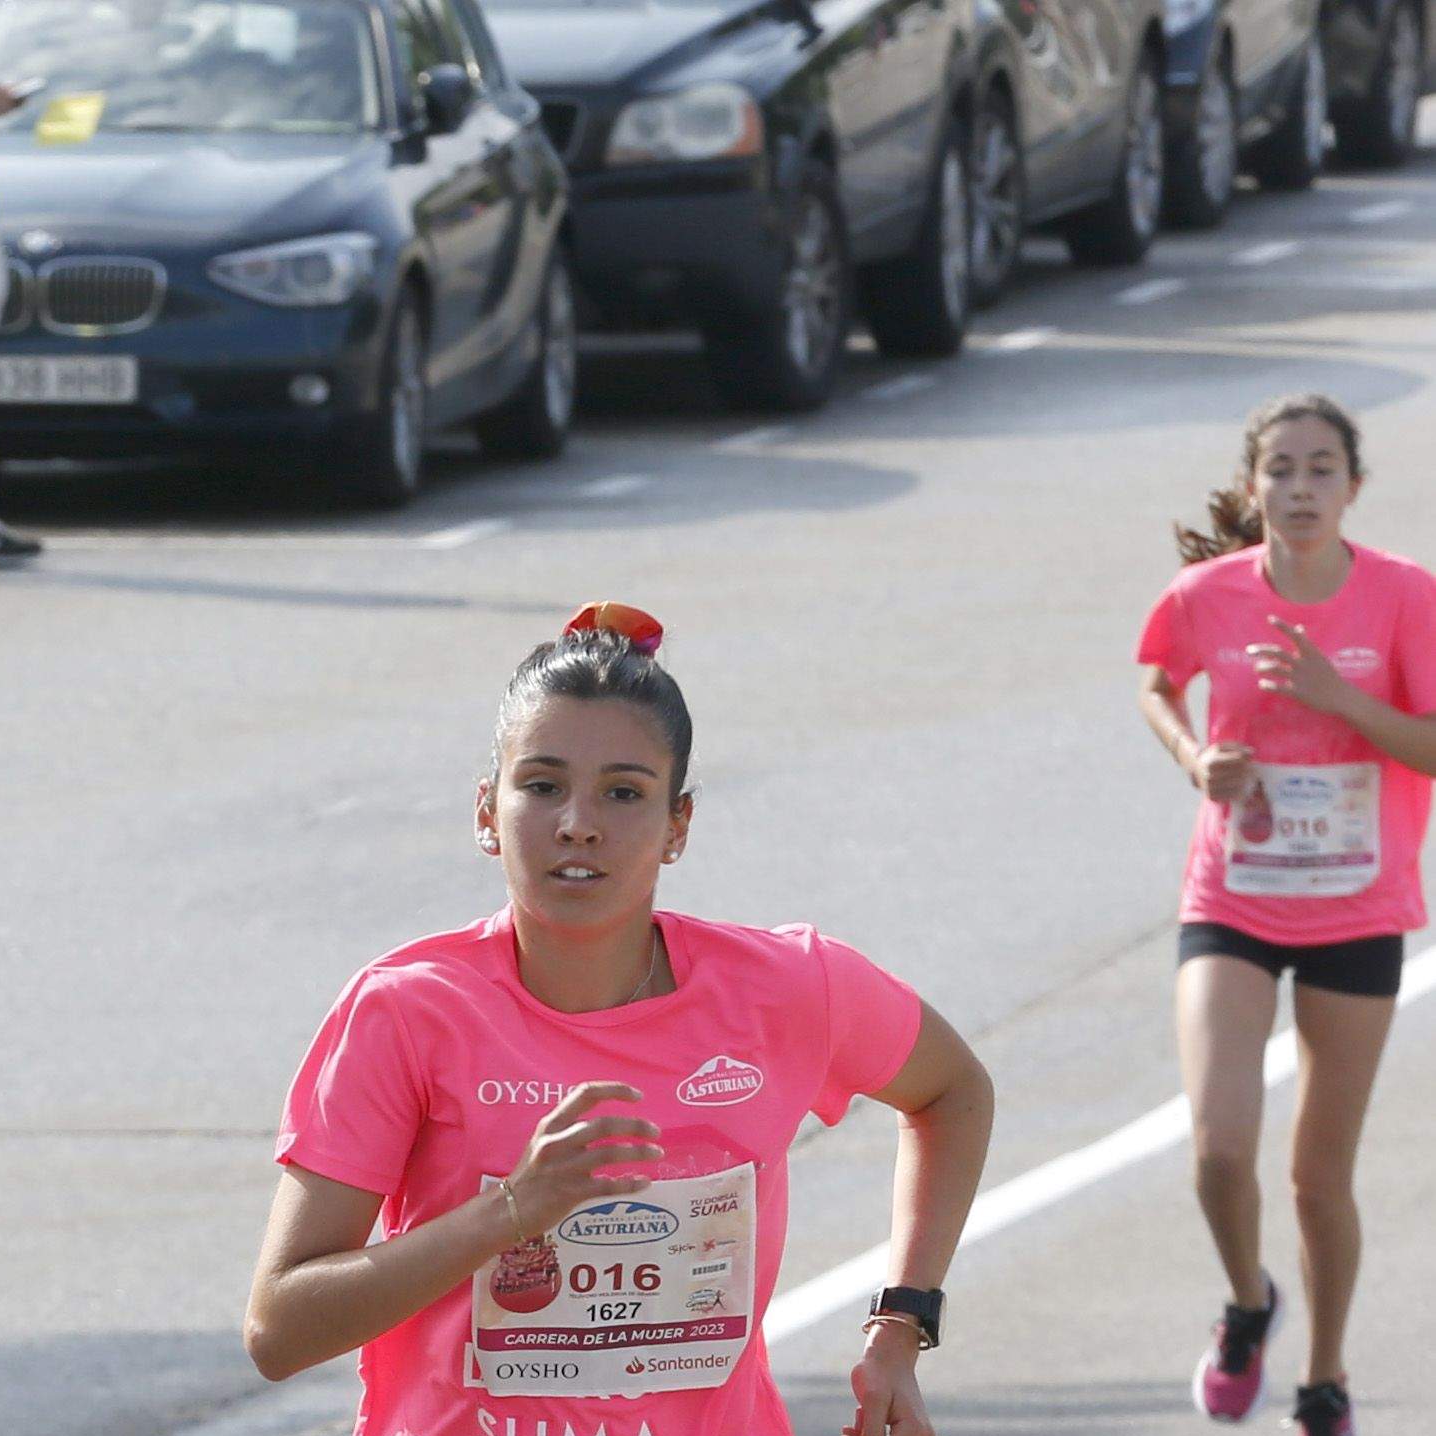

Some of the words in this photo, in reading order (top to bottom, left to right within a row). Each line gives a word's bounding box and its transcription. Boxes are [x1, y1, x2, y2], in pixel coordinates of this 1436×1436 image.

[686, 1075, 758, 1100] ASTURIANA
[689, 1200, 739, 1218] SUMA
[567, 1220, 670, 1237] ASTURIANA
[569, 1263, 662, 1294] 016
[587, 1302, 642, 1322] 1627
[504, 1333, 579, 1346] CARRERA
[582, 1333, 605, 1346] DE
[608, 1331, 628, 1343] LA
[631, 1327, 685, 1341] MUJER
[689, 1323, 726, 1337] 2023
[496, 1363, 579, 1380] OYSHO
[648, 1354, 731, 1373] Santander
